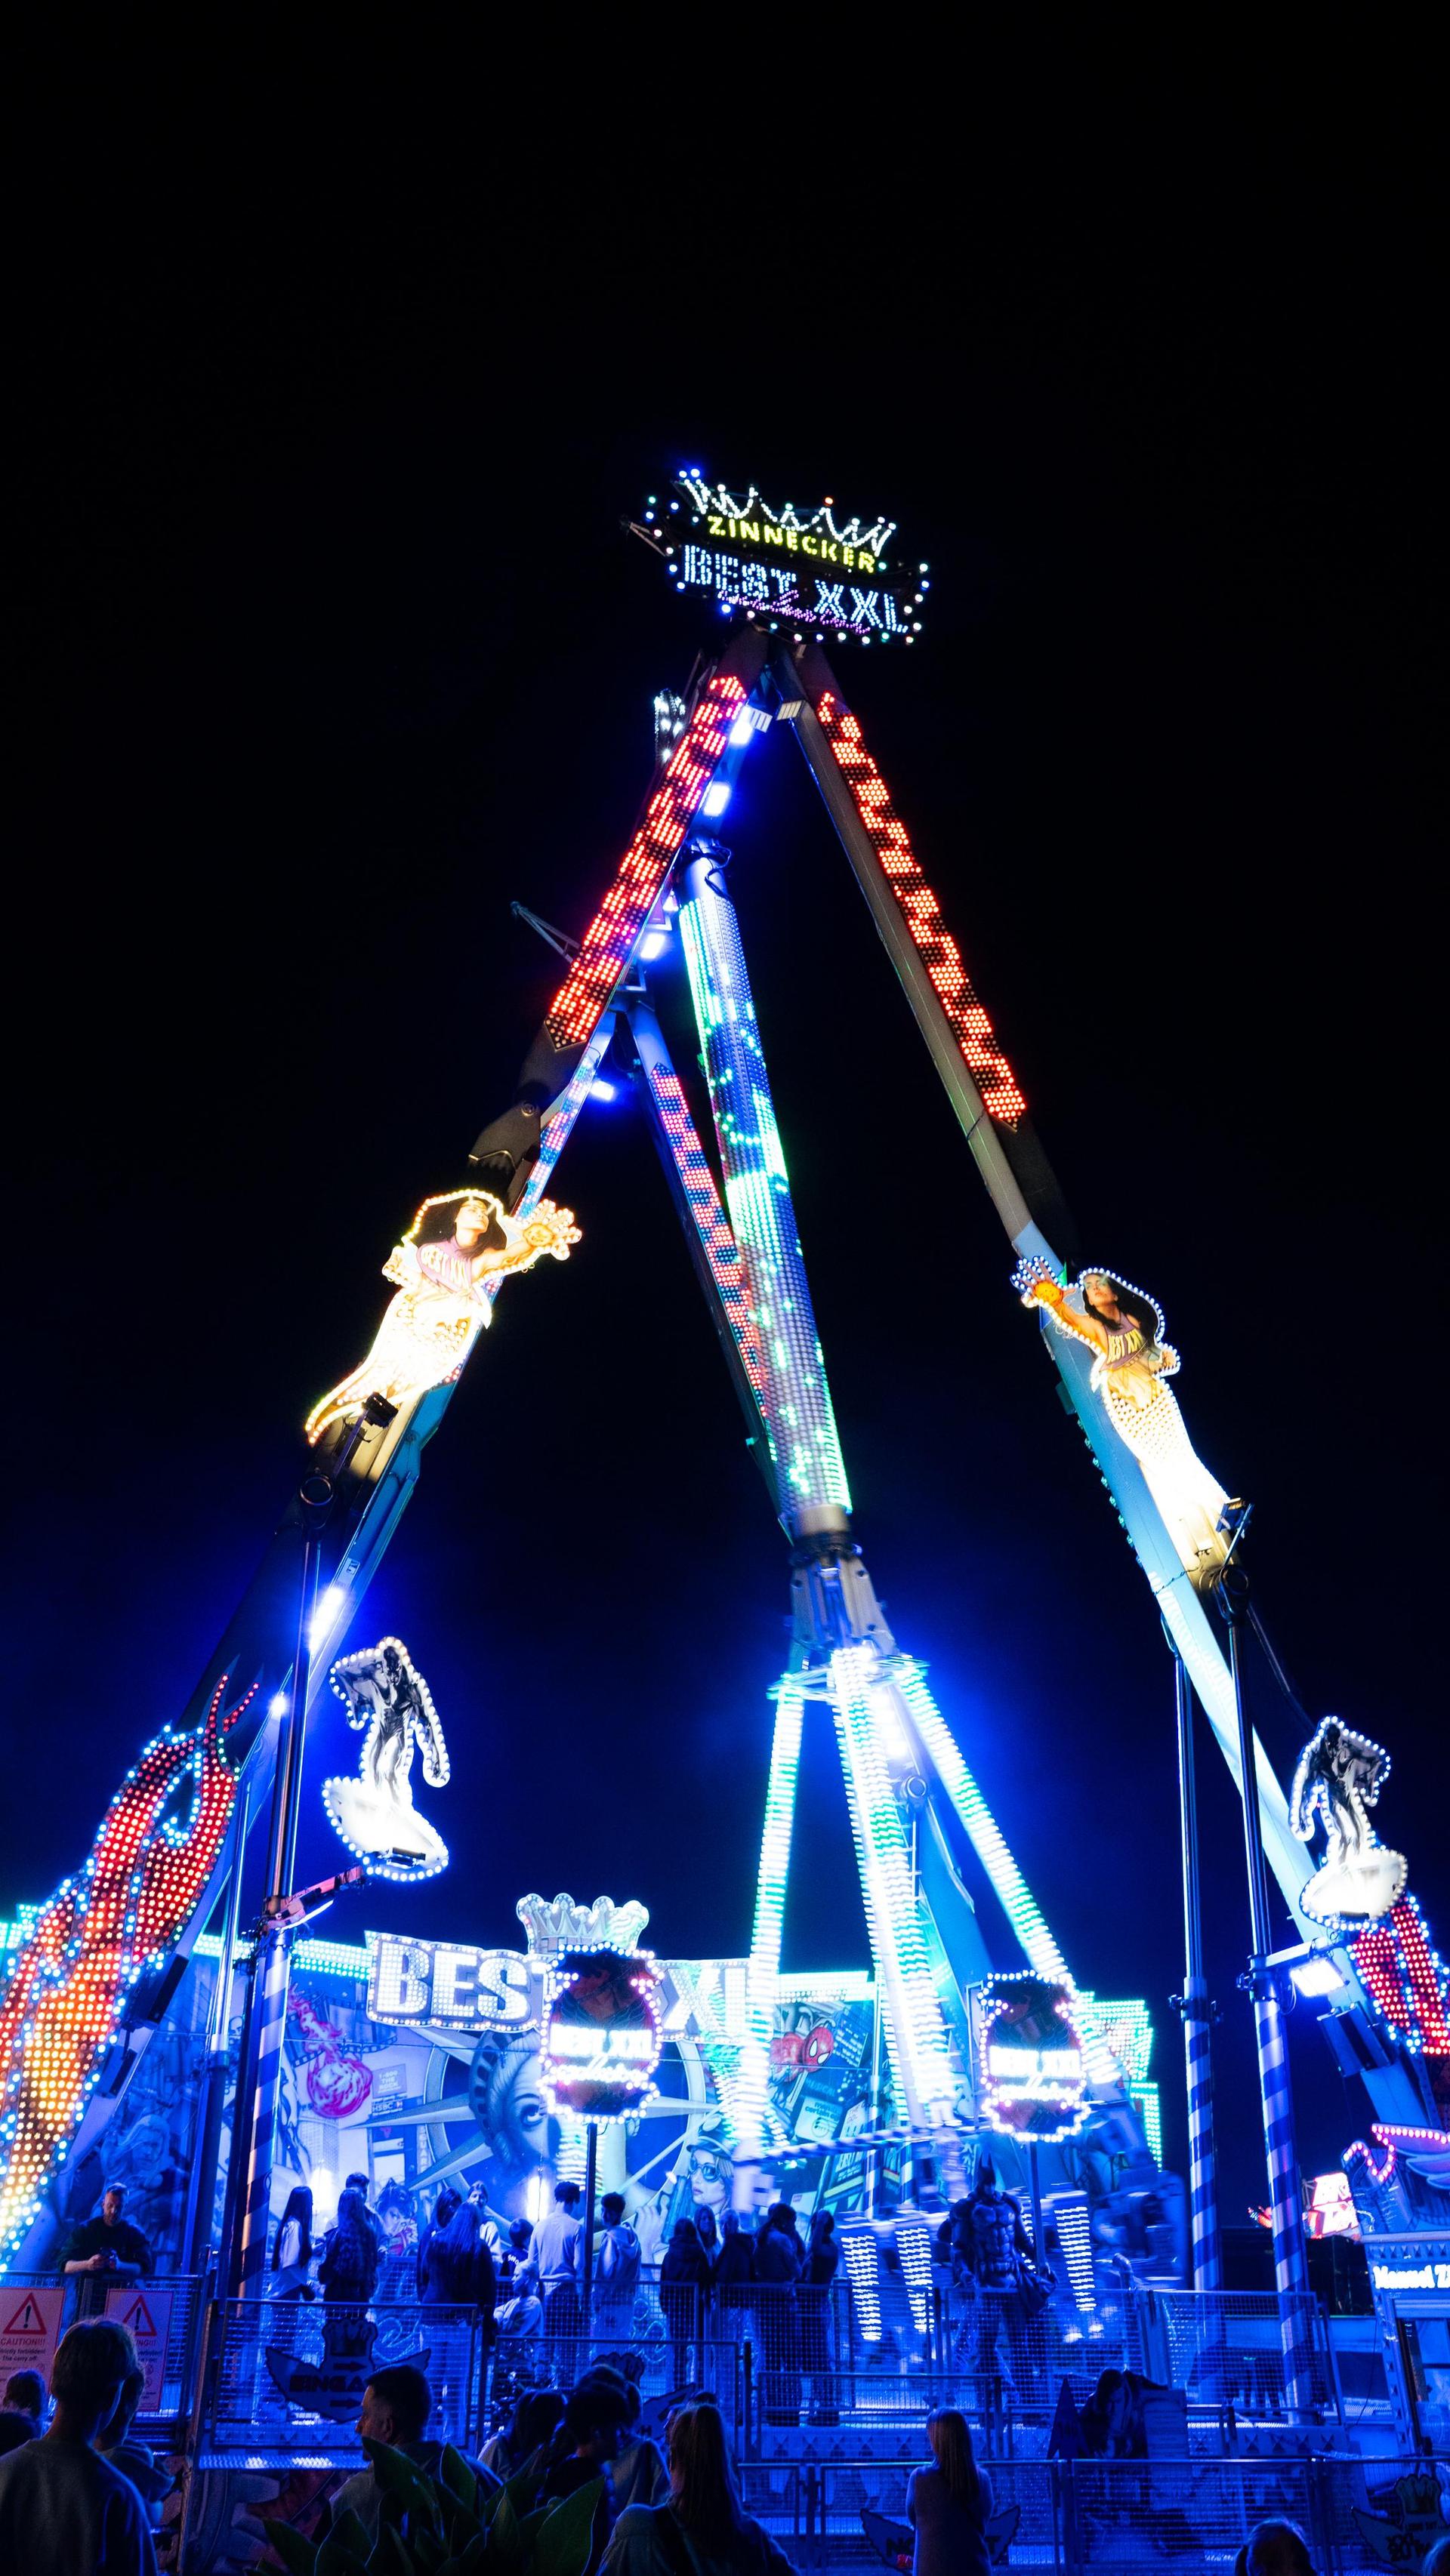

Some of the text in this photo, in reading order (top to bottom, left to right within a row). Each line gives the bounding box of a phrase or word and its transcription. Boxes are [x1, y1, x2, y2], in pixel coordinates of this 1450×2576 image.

[707, 516, 875, 574] ZINNECKER
[684, 544, 797, 598] BEST
[814, 579, 909, 633] XXL
